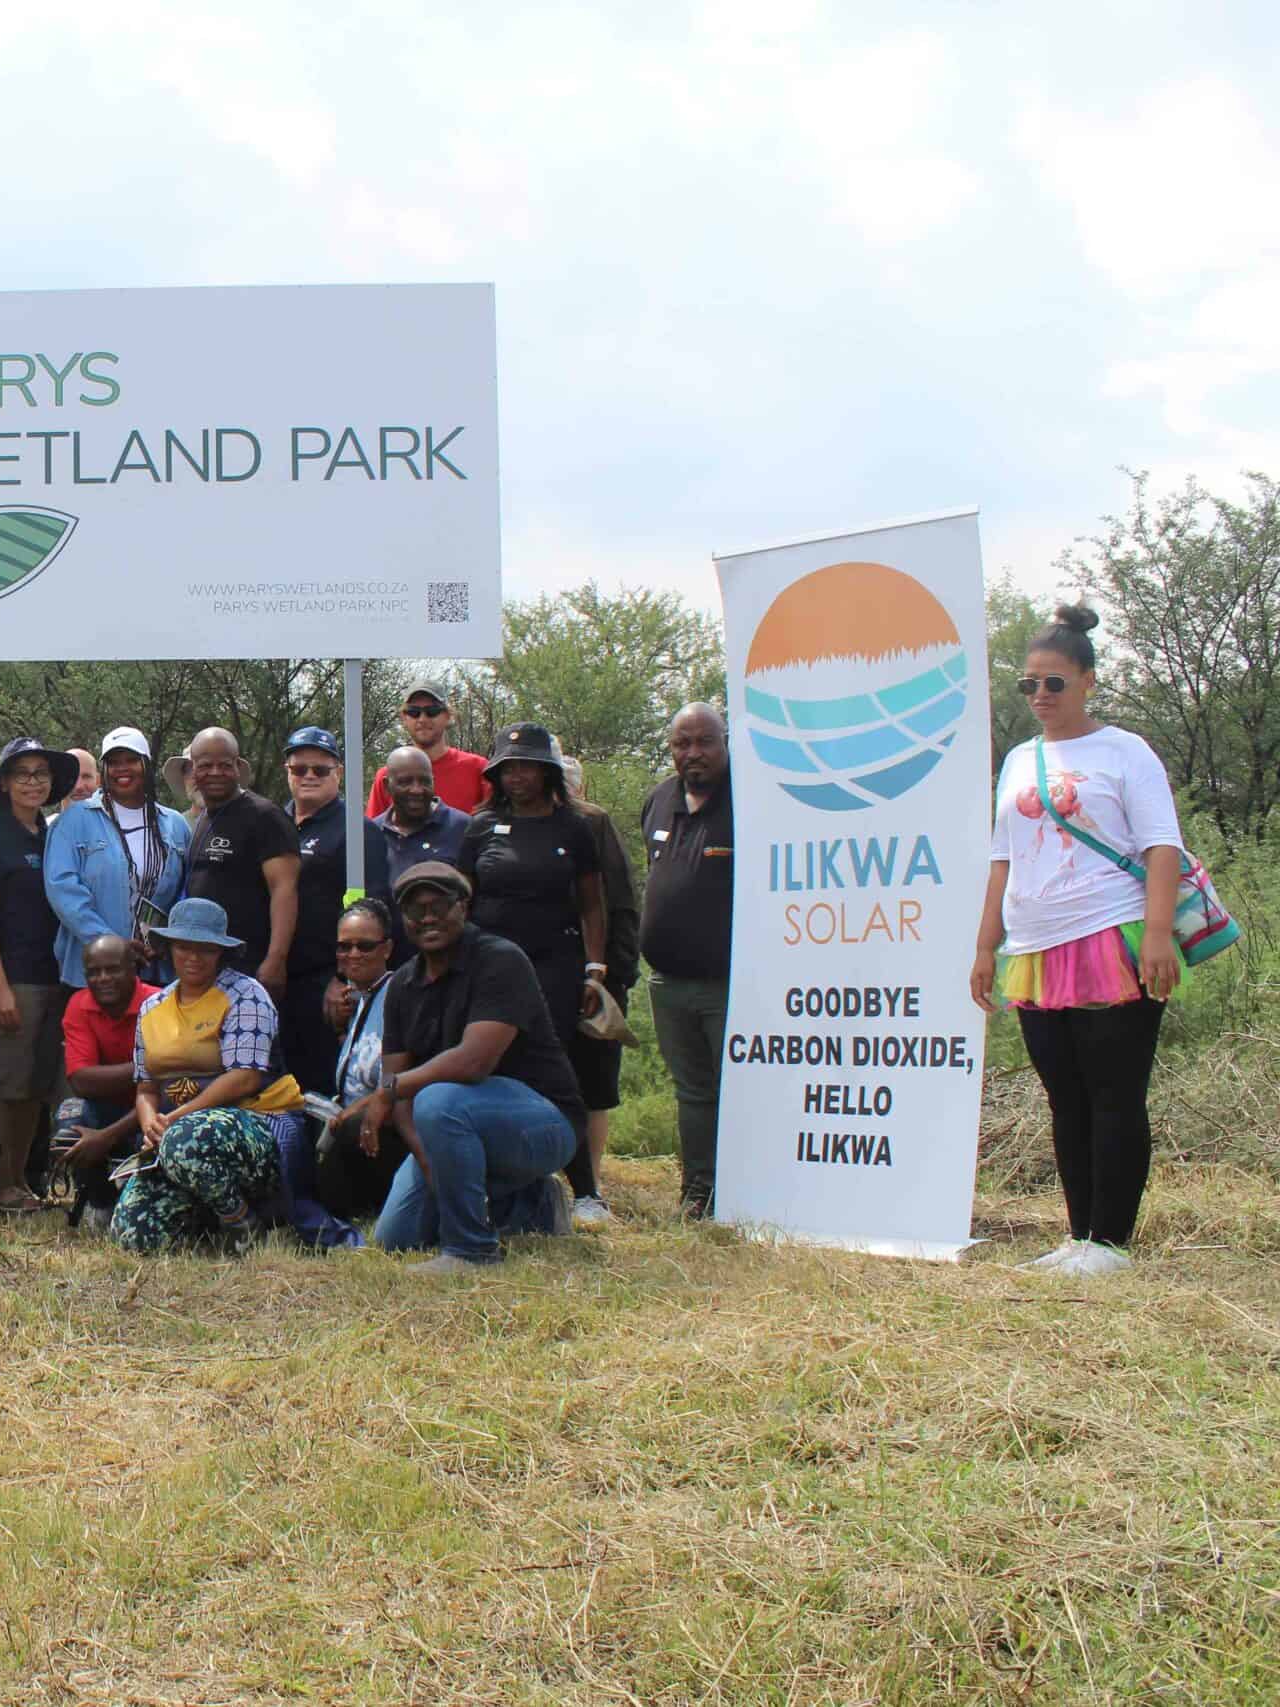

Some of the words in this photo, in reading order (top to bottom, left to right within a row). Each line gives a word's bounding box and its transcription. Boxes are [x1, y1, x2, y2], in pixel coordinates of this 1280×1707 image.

[291, 426, 468, 482] PARK
[187, 582, 409, 596] WWW.PARYSWETLANDS.CO.ZA
[213, 600, 259, 613] PARYS
[264, 599, 336, 612] WETLAND
[340, 599, 376, 612] PARK
[380, 599, 409, 612] NPC
[769, 835, 943, 891] ILIKWA
[783, 900, 923, 945] SOLAR
[785, 986, 920, 1018] GOODBYE
[728, 1034, 842, 1065] CARBON
[852, 1036, 974, 1075] DIOXIDE,
[804, 1083, 892, 1117] HELLO
[797, 1131, 892, 1167] ILIKWA
